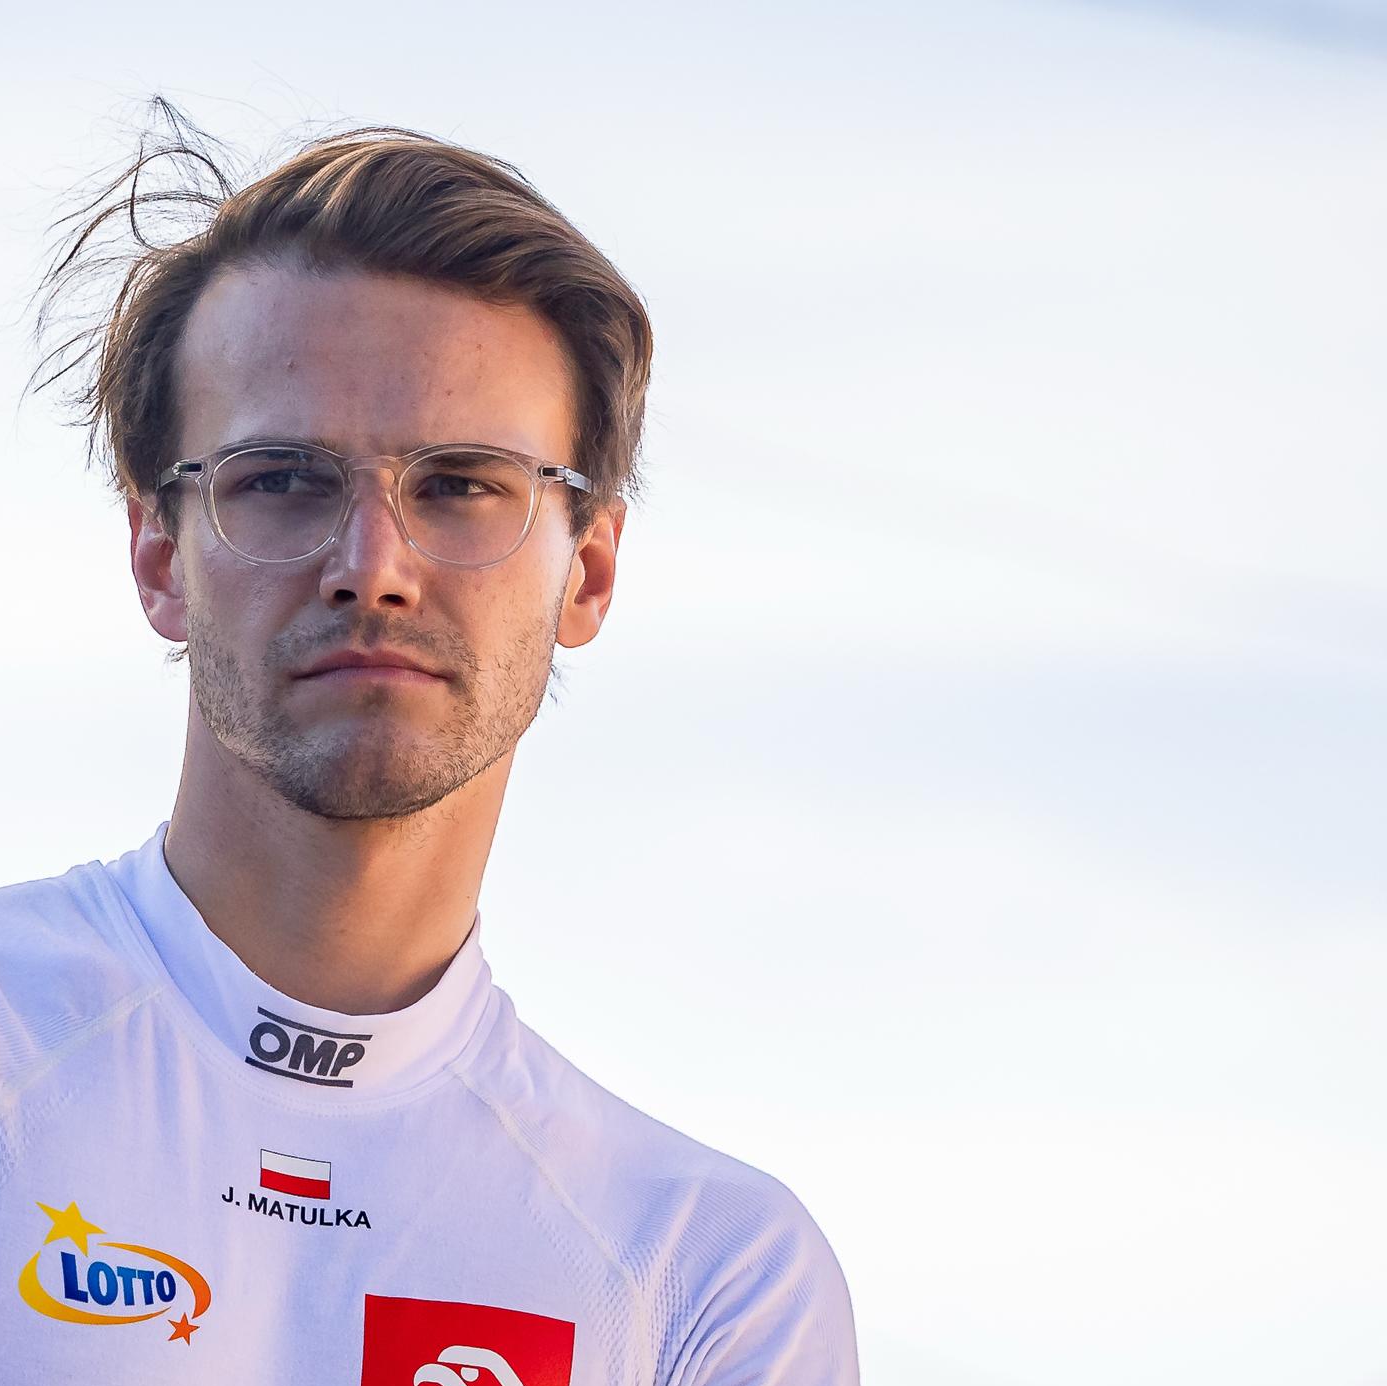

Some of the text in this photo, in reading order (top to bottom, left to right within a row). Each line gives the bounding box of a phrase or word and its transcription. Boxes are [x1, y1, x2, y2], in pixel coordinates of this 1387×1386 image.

[249, 1020, 366, 1078] OMP
[221, 1187, 372, 1230] J. MATULKA
[60, 1252, 177, 1307] LOTTO
